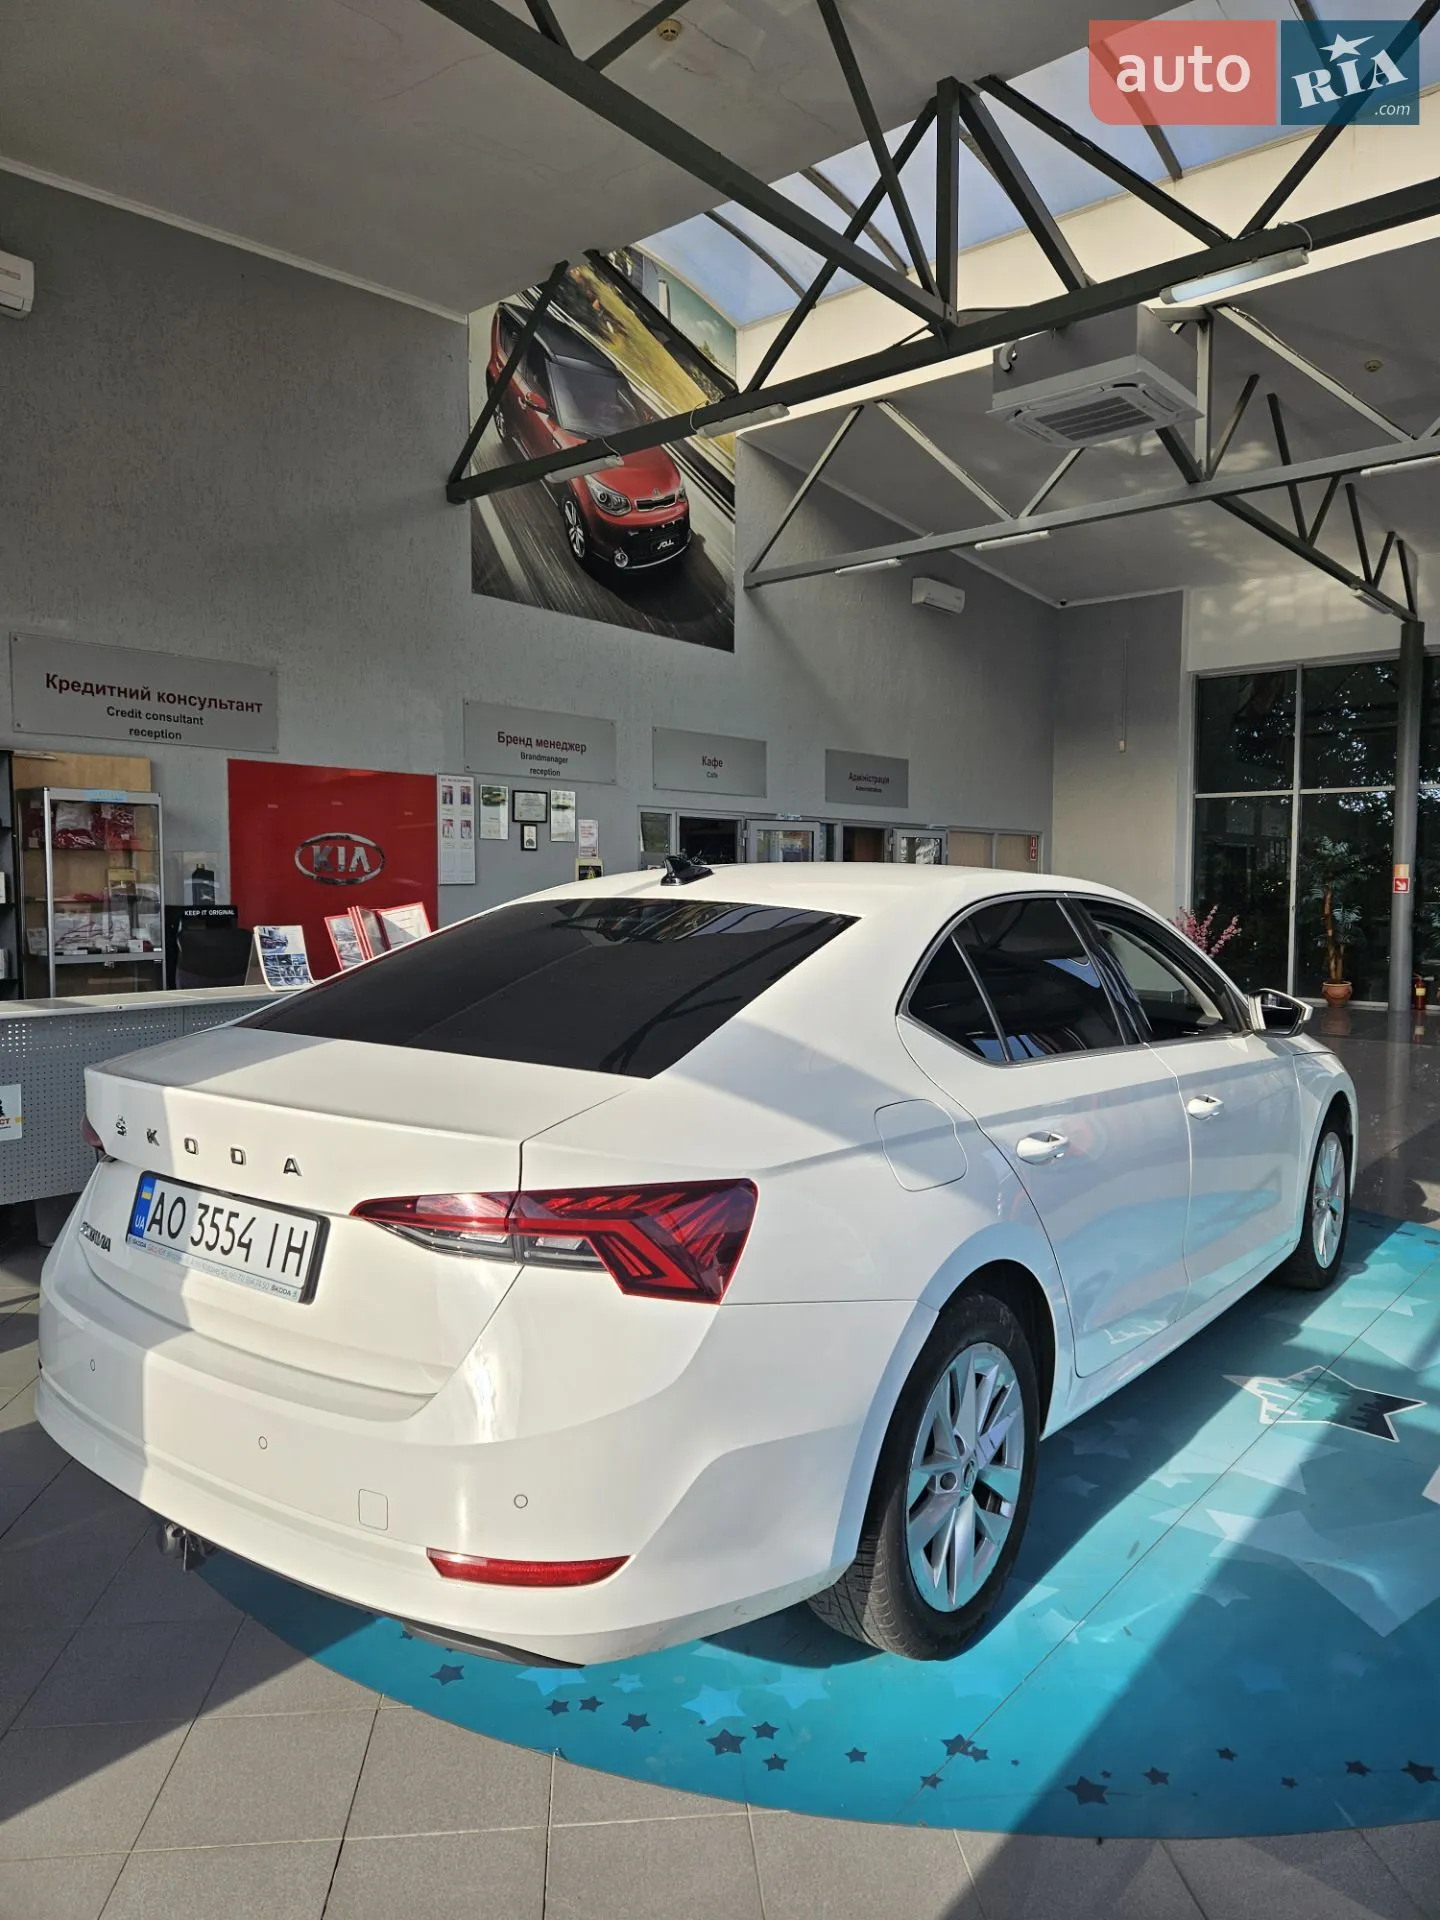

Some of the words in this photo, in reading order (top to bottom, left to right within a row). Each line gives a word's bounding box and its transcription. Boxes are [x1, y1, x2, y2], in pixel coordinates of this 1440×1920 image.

[45, 672, 151, 702] Кредитний
[157, 690, 263, 714] консультант
[106, 706, 143, 720] Credit
[145, 711, 204, 726] consultant
[129, 727, 182, 741] reception
[497, 731, 533, 749] Бренд
[535, 737, 587, 754] менеджер
[520, 751, 568, 765] Brandmanager
[702, 755, 724, 769] Кафе
[529, 767, 561, 777] reception
[311, 845, 372, 873] KIA
[135, 1214, 146, 1230] UA
[146, 1191, 187, 1240] AO
[190, 1202, 256, 1263] 3554
[266, 1223, 308, 1278] IH
